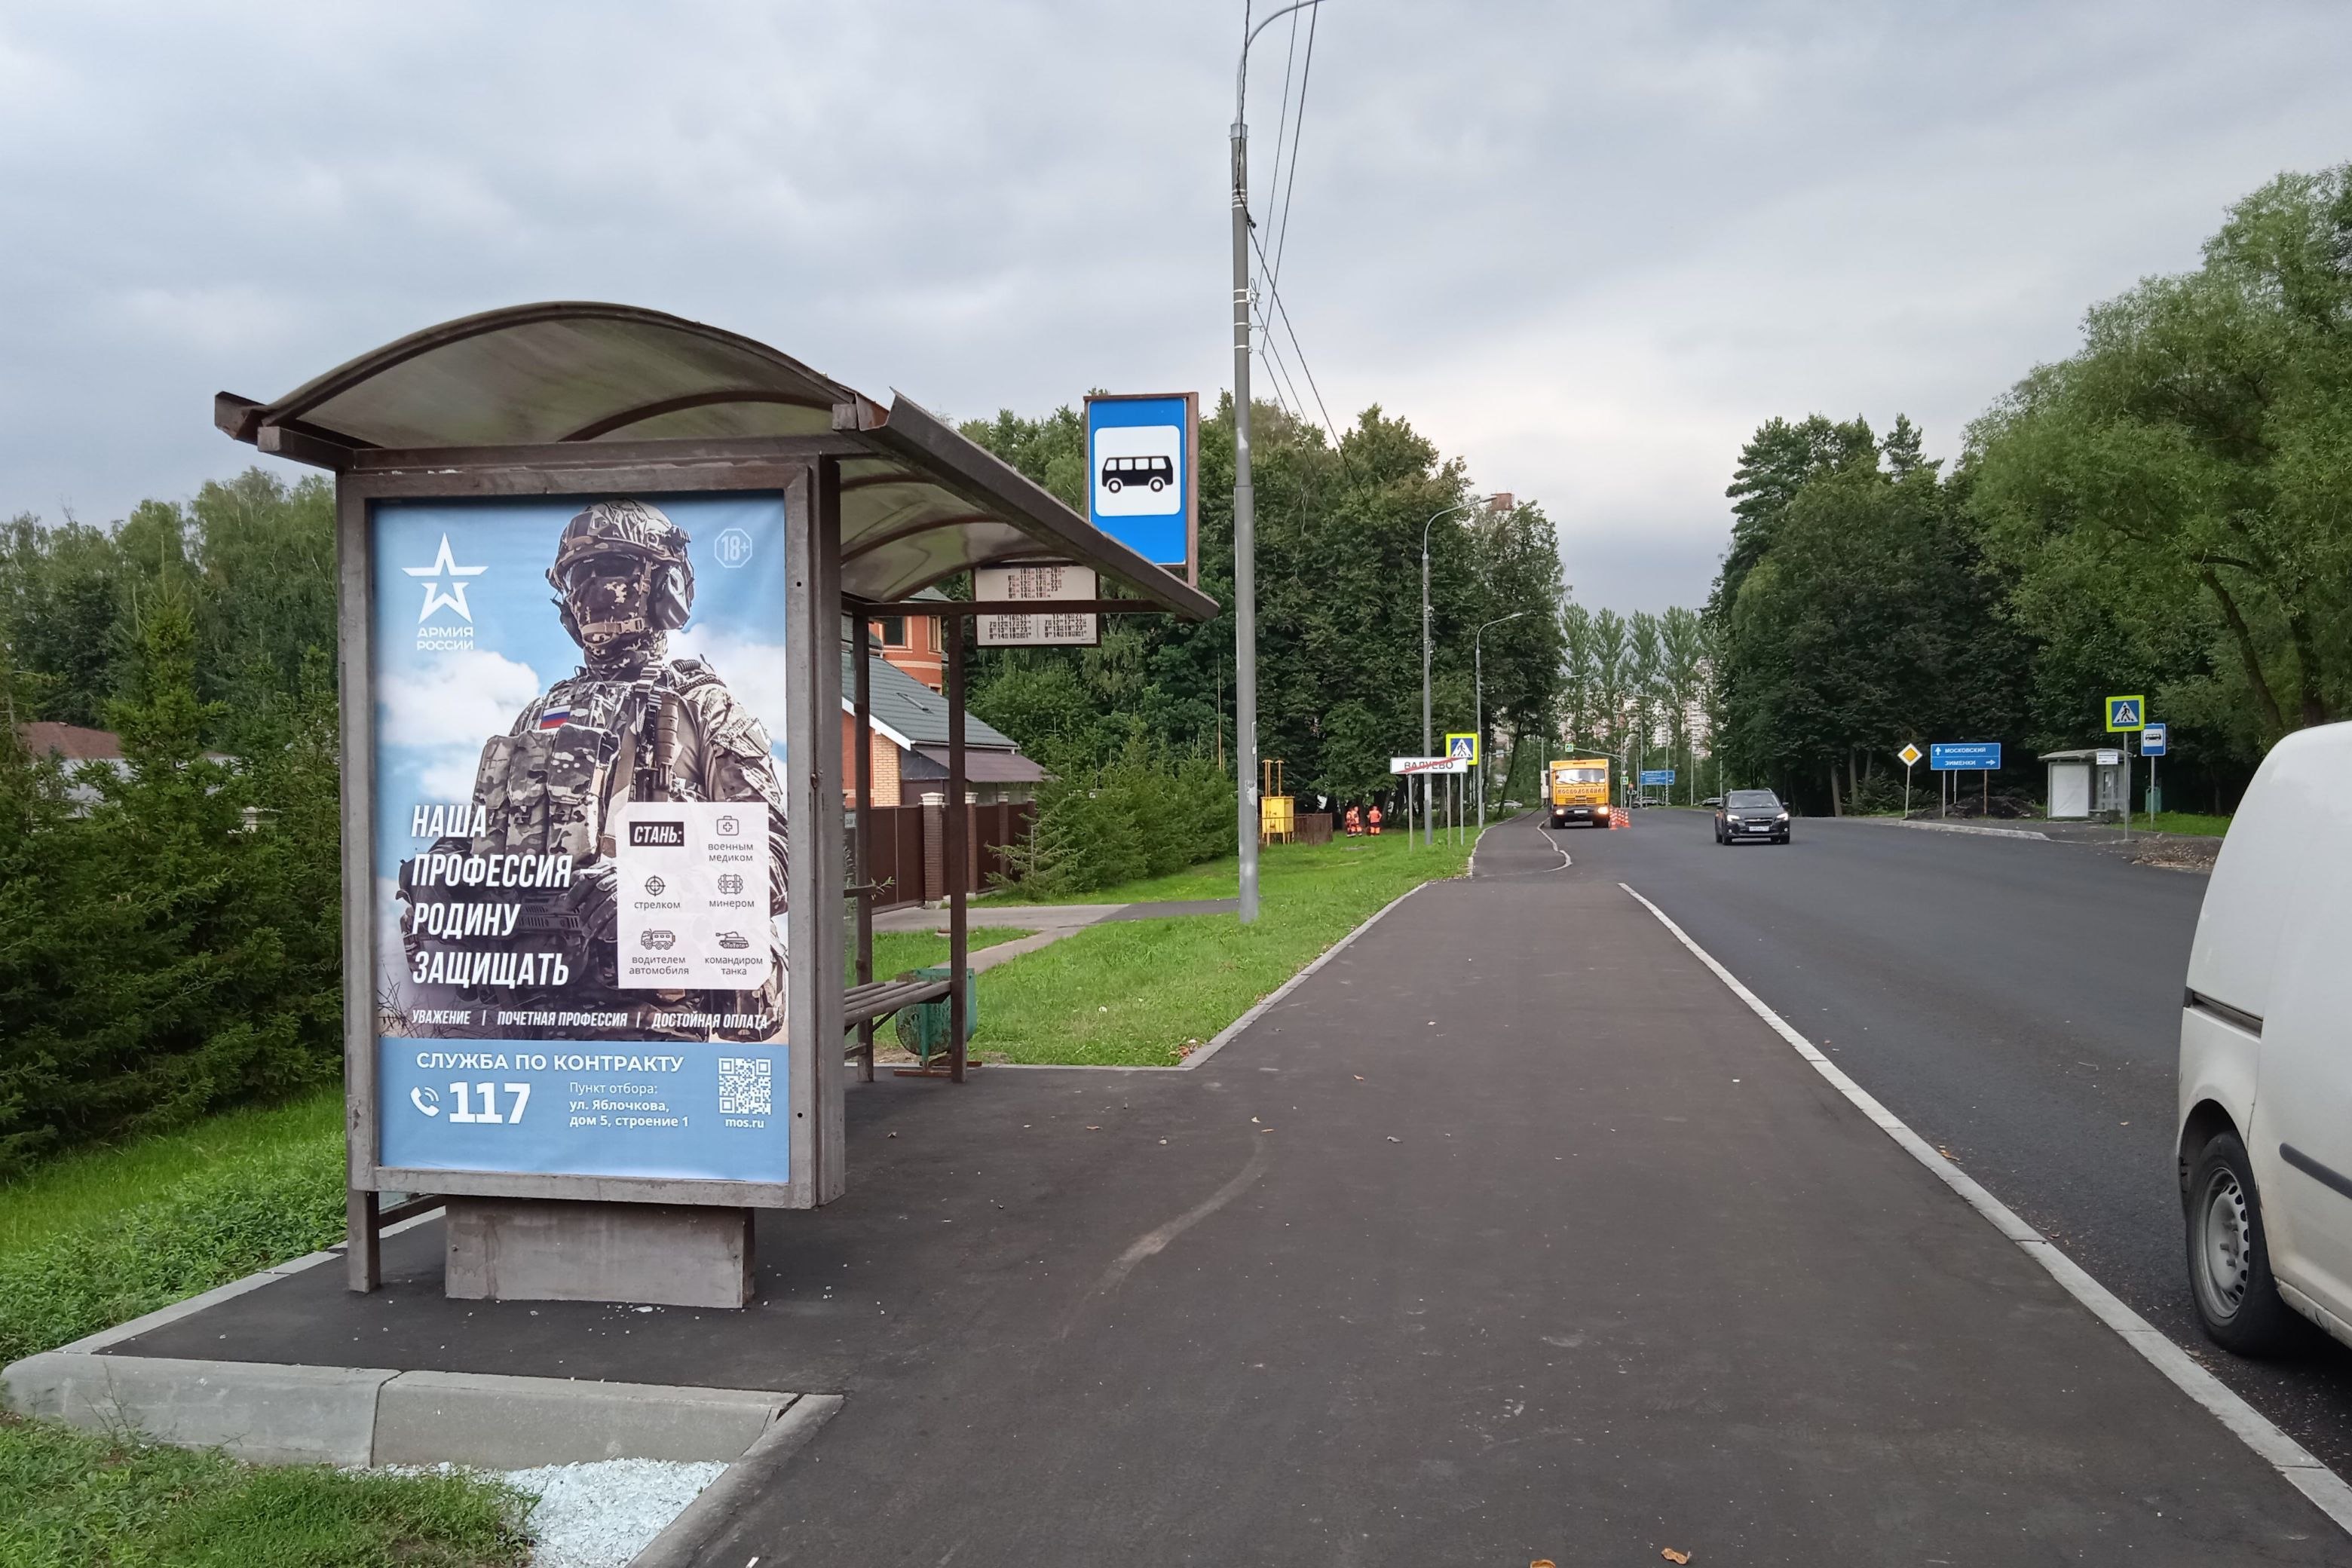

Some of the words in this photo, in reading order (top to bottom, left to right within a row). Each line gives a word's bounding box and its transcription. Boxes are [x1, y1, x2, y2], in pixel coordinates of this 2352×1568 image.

[721, 535, 749, 561] 18+
[417, 626, 473, 638] АРМИЯ
[416, 640, 474, 651] РОССИИ
[1404, 761, 1453, 770] ВАЛУЕВО
[412, 804, 486, 838] НАША
[633, 825, 682, 844] СТАНЬ:
[708, 843, 754, 851] военным
[709, 854, 753, 862] медиком
[412, 853, 573, 888] ПРОФЕССИЯ
[634, 902, 681, 911] стрелком
[709, 899, 755, 908] минером
[412, 902, 522, 940] РОДИНУ
[632, 956, 686, 964] водителем
[705, 957, 763, 965] командиром
[412, 951, 570, 990] ЗАЩИЩАТЬ
[629, 965, 689, 975] автомобиля
[721, 967, 747, 975] танка
[412, 1009, 472, 1025] УВАЖЕНИЕ
[497, 1011, 556, 1027] ПОЧЕТНАЯ
[558, 1012, 628, 1027] ПРОФЕССИЯ
[651, 1011, 721, 1029] ДОСТОЙНАЯ
[723, 1014, 768, 1030] ОПЛАТА
[416, 1052, 509, 1070] СЛУЖБА
[516, 1054, 547, 1071] ПО
[554, 1055, 684, 1073] КОНТРАКТУ
[569, 1083, 605, 1096] Пункт
[609, 1083, 658, 1097] отбора:
[449, 1081, 531, 1124] 117
[569, 1101, 589, 1112] ул.
[592, 1098, 669, 1113] Яблочкова,
[569, 1118, 597, 1128] дом
[600, 1116, 611, 1129] 5,
[615, 1119, 678, 1129] строение
[681, 1116, 689, 1127] 1
[725, 1117, 765, 1129] mos.ru
